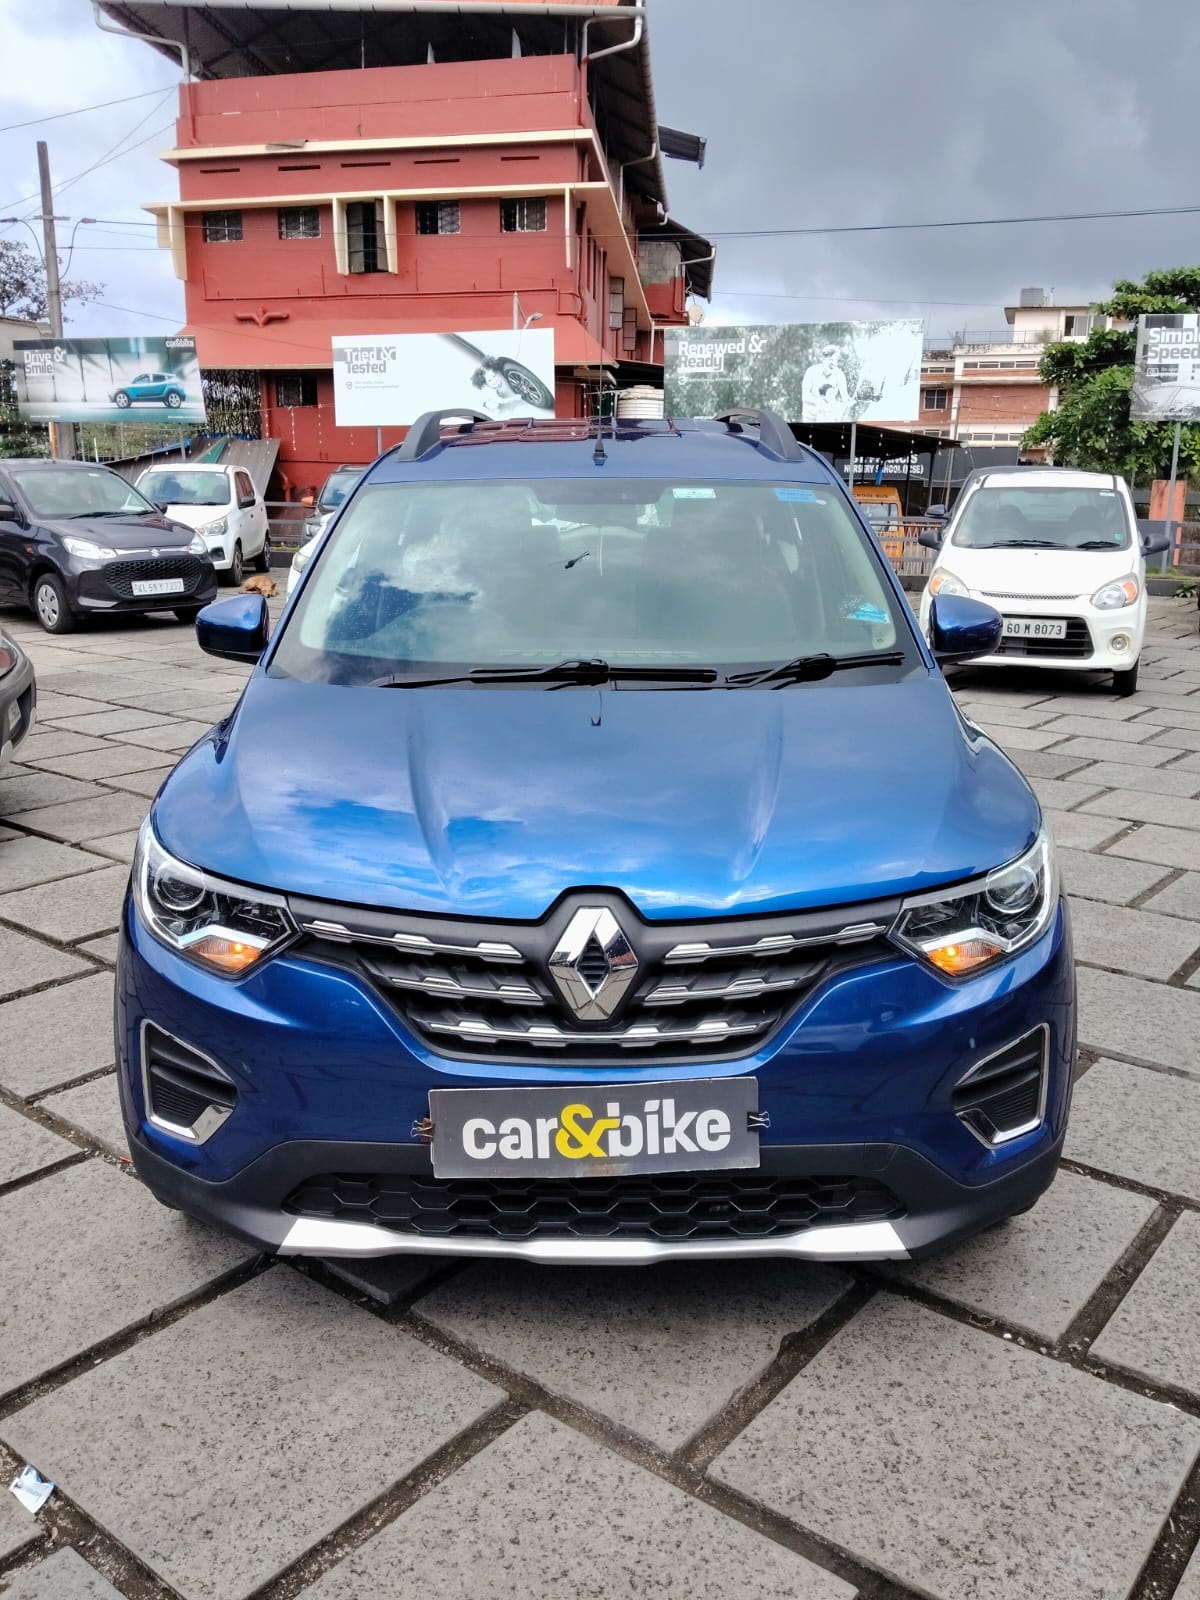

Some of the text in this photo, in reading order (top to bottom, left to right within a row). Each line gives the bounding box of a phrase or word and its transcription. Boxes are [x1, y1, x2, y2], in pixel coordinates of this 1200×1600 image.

[1149, 326, 1200, 345] Simpl
[678, 335, 767, 356] Renewed &
[24, 346, 67, 363] Drive &
[344, 347, 377, 362] Tried
[679, 354, 723, 371] Ready
[25, 361, 54, 374] Smile
[344, 360, 387, 374] Tested
[843, 464, 875, 474] NRSERY
[876, 464, 901, 474] SHOOL
[1006, 622, 1063, 636] 60 M 8073
[462, 1098, 731, 1160] car&bike
